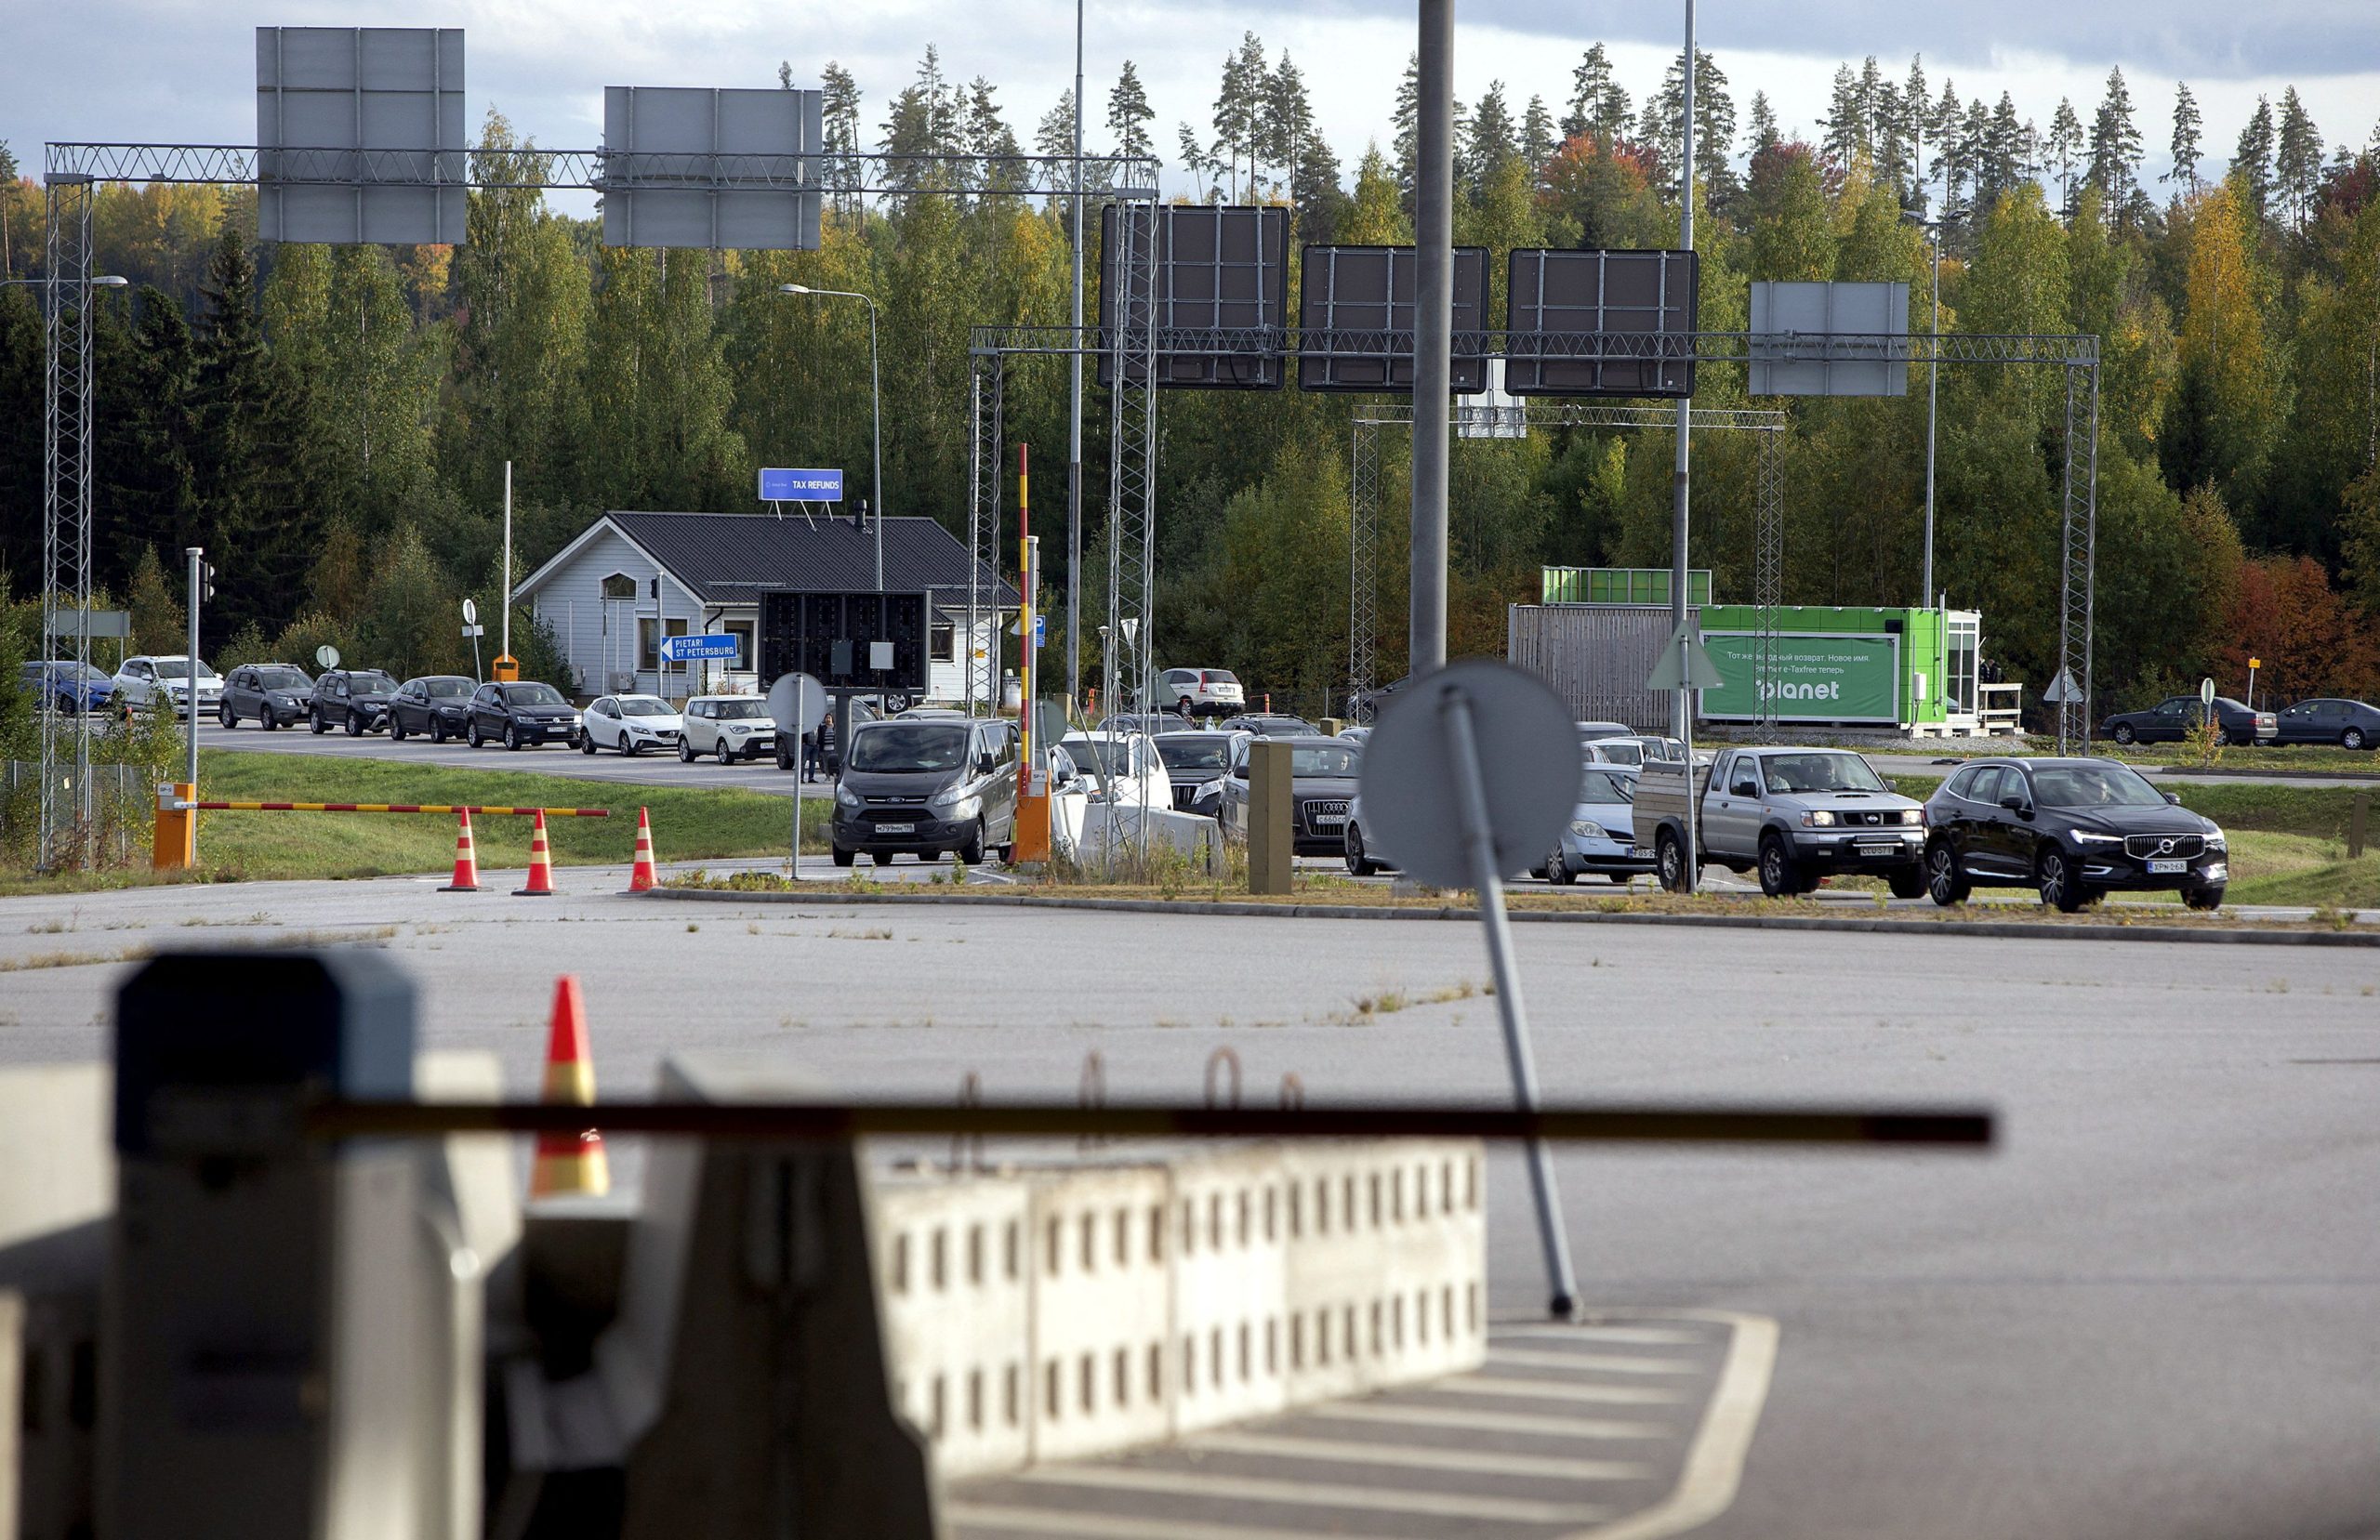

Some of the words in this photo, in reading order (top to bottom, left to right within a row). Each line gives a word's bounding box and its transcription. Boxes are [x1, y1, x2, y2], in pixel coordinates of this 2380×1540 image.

[793, 480, 806, 490] TAX
[808, 480, 840, 490] REFUNDS
[675, 638, 703, 648] PIETARI
[676, 649, 685, 657] ST
[687, 647, 734, 657] PETERSBURG
[1727, 652, 1740, 660] Тот
[1793, 654, 1827, 663] возврат.
[1783, 665, 1818, 673] e-Taxfree
[1818, 666, 1844, 675] теперь
[1756, 679, 1840, 701] planet
